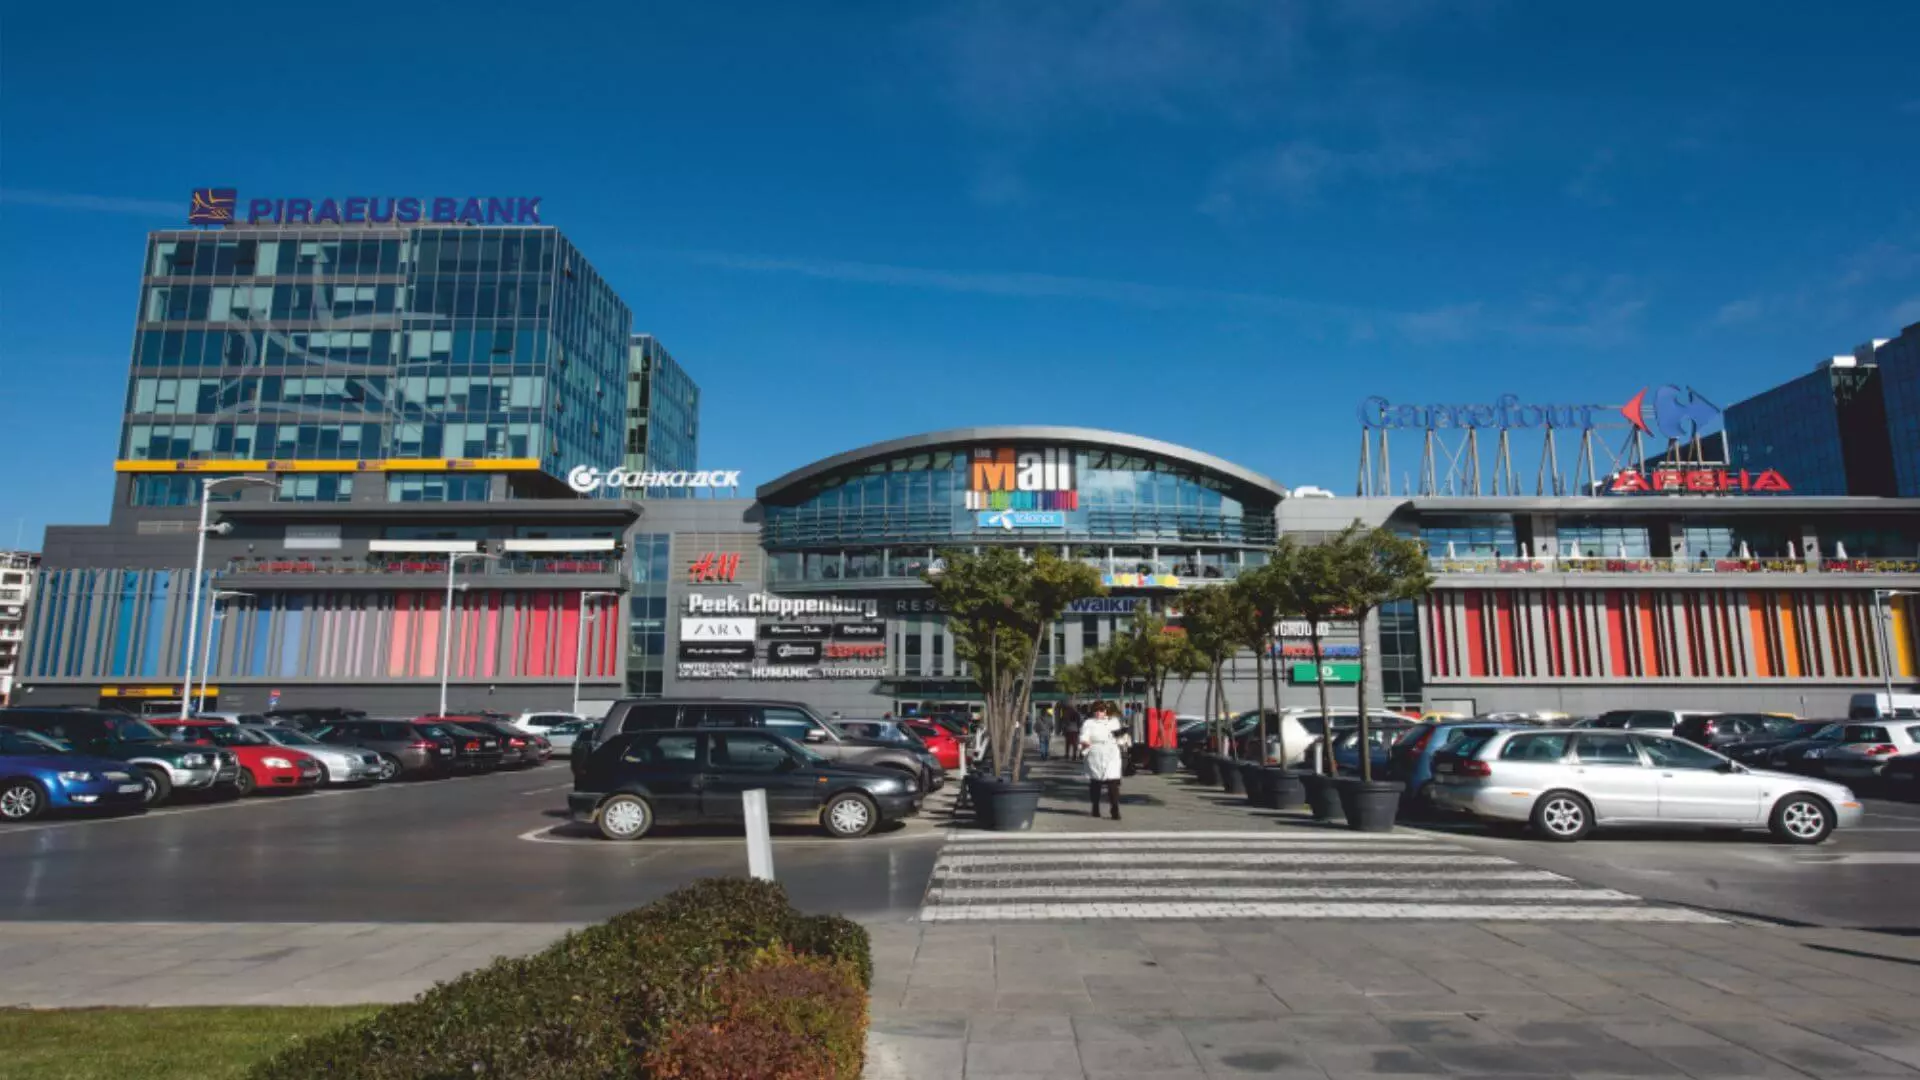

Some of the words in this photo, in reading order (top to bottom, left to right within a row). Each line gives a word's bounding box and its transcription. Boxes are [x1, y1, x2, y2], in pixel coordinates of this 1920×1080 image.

[248, 197, 421, 224] PIRAEUS
[432, 197, 543, 224] BANK
[1357, 393, 1604, 429] Carrefour
[974, 448, 1070, 491] Mall
[689, 593, 739, 613] Peek
[749, 591, 878, 617] Cloppenburg
[694, 623, 742, 636] ZARA
[752, 666, 813, 677] HUMANIC
